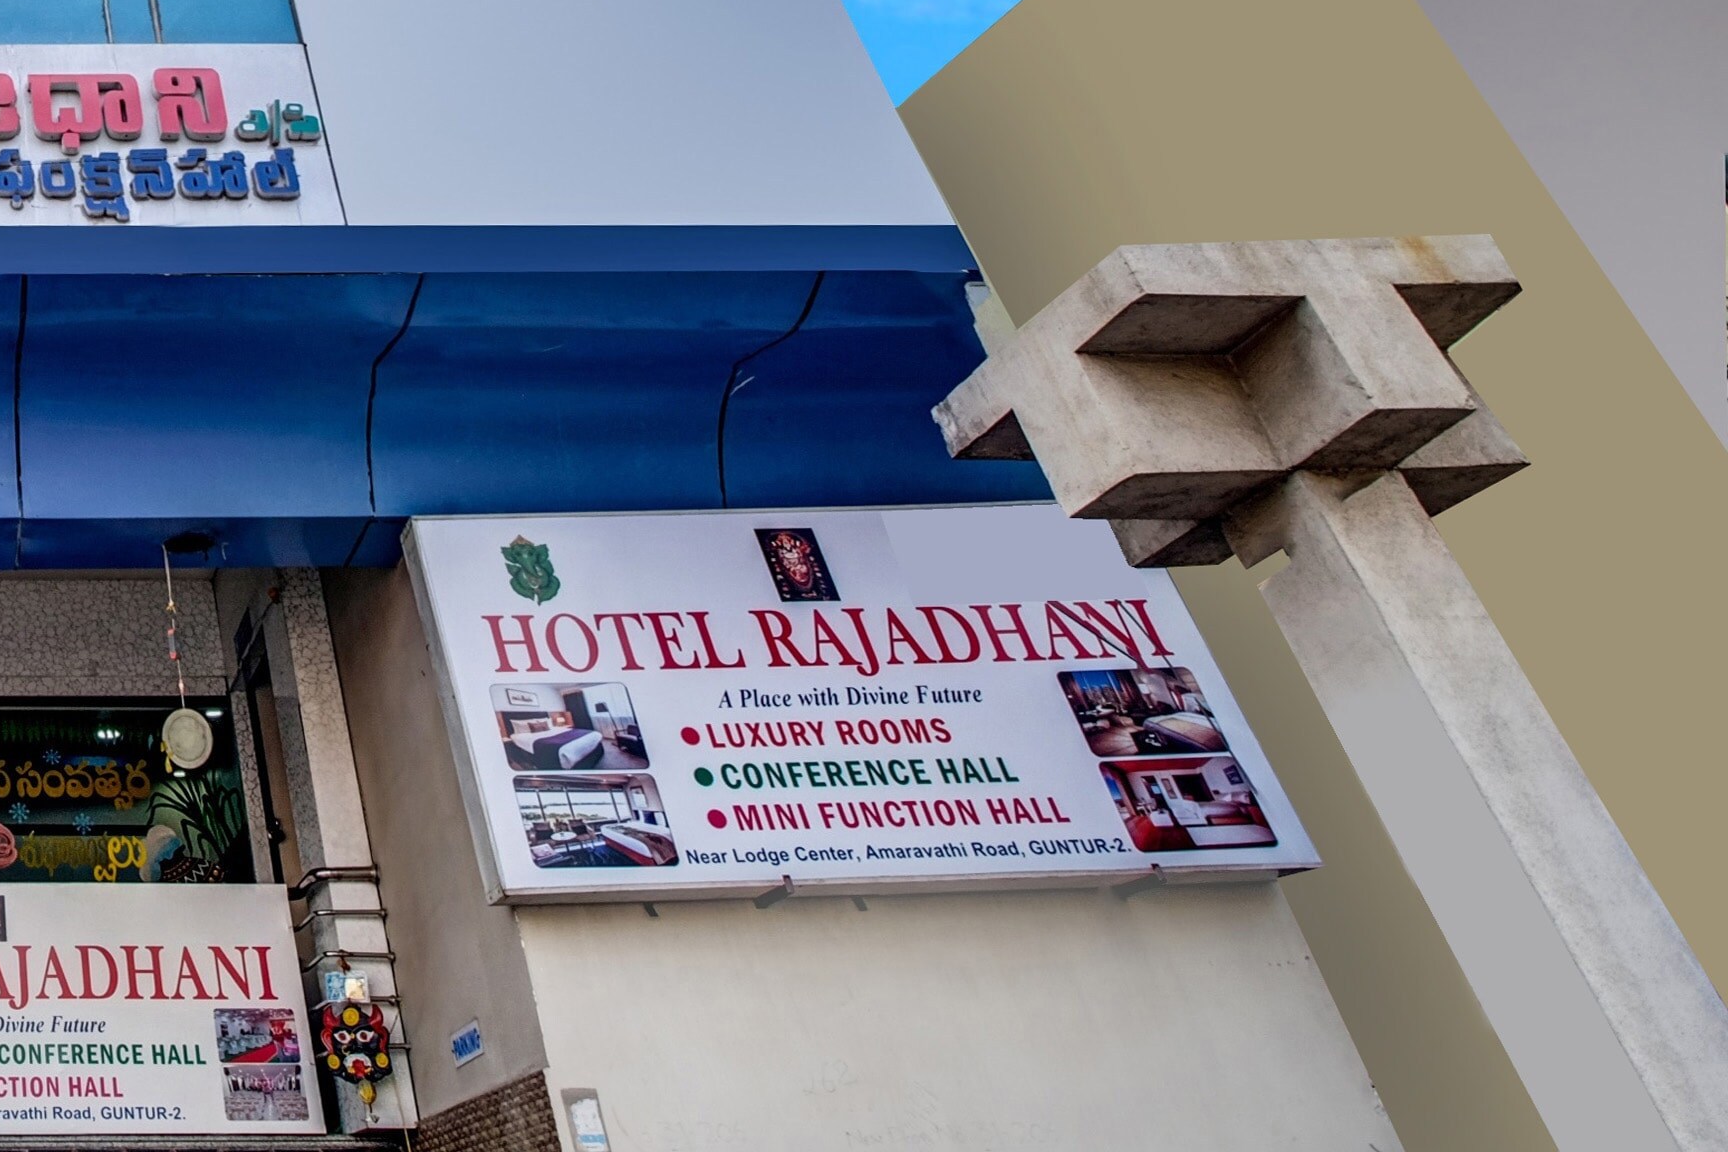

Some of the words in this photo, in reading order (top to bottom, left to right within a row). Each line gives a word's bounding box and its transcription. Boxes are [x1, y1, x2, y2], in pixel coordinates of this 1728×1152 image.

[481, 611, 747, 673] HOTEL
[749, 598, 1175, 677] RAJADHANI
[718, 690, 733, 709] A
[739, 688, 792, 708] Place
[797, 687, 840, 707] with
[846, 686, 909, 706] Divine
[917, 685, 983, 704] Future
[706, 720, 825, 749] LUXURY
[835, 717, 952, 746] ROOMS
[720, 758, 929, 790] CONFERENCE
[935, 756, 1020, 785] HALL
[732, 803, 811, 831] MINI
[820, 799, 981, 829] FUNCTION
[985, 796, 1071, 825] HALL
[685, 849, 728, 865] Near
[732, 847, 790, 867] Lodge
[794, 846, 861, 862] Center,
[866, 842, 968, 860] Amaravathi
[970, 841, 1026, 858] Road,
[1028, 834, 1134, 856] GUNTUR-2.
[51, 1015, 106, 1034] Future
[151, 1044, 207, 1065] HALL
[68, 1076, 124, 1098] HALL
[52, 1106, 96, 1122] Road,
[100, 1106, 186, 1120] GUNTUR-2.
